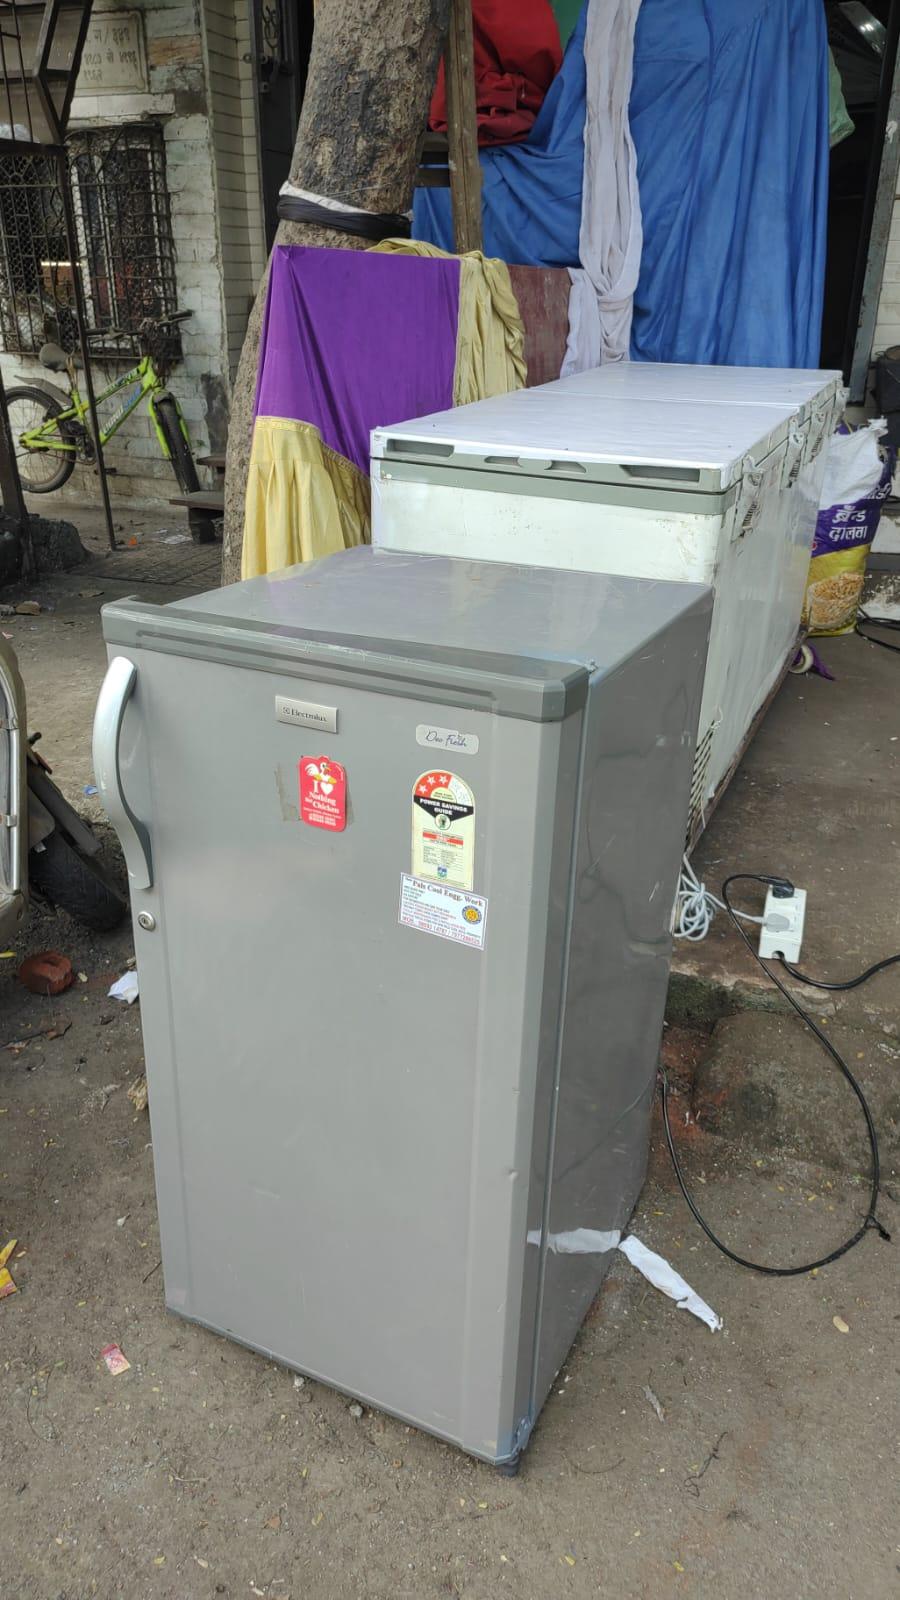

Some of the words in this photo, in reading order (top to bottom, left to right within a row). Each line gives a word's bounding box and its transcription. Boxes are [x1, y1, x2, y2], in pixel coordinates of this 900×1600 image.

[291, 707, 327, 722] Electrolux
[309, 791, 337, 806] Nothing
[420, 798, 441, 807] POWER
[442, 802, 468, 813] SAVINGS
[312, 801, 339, 814] Chicken
[434, 807, 453, 815] GUIDE
[464, 895, 483, 907] Work
